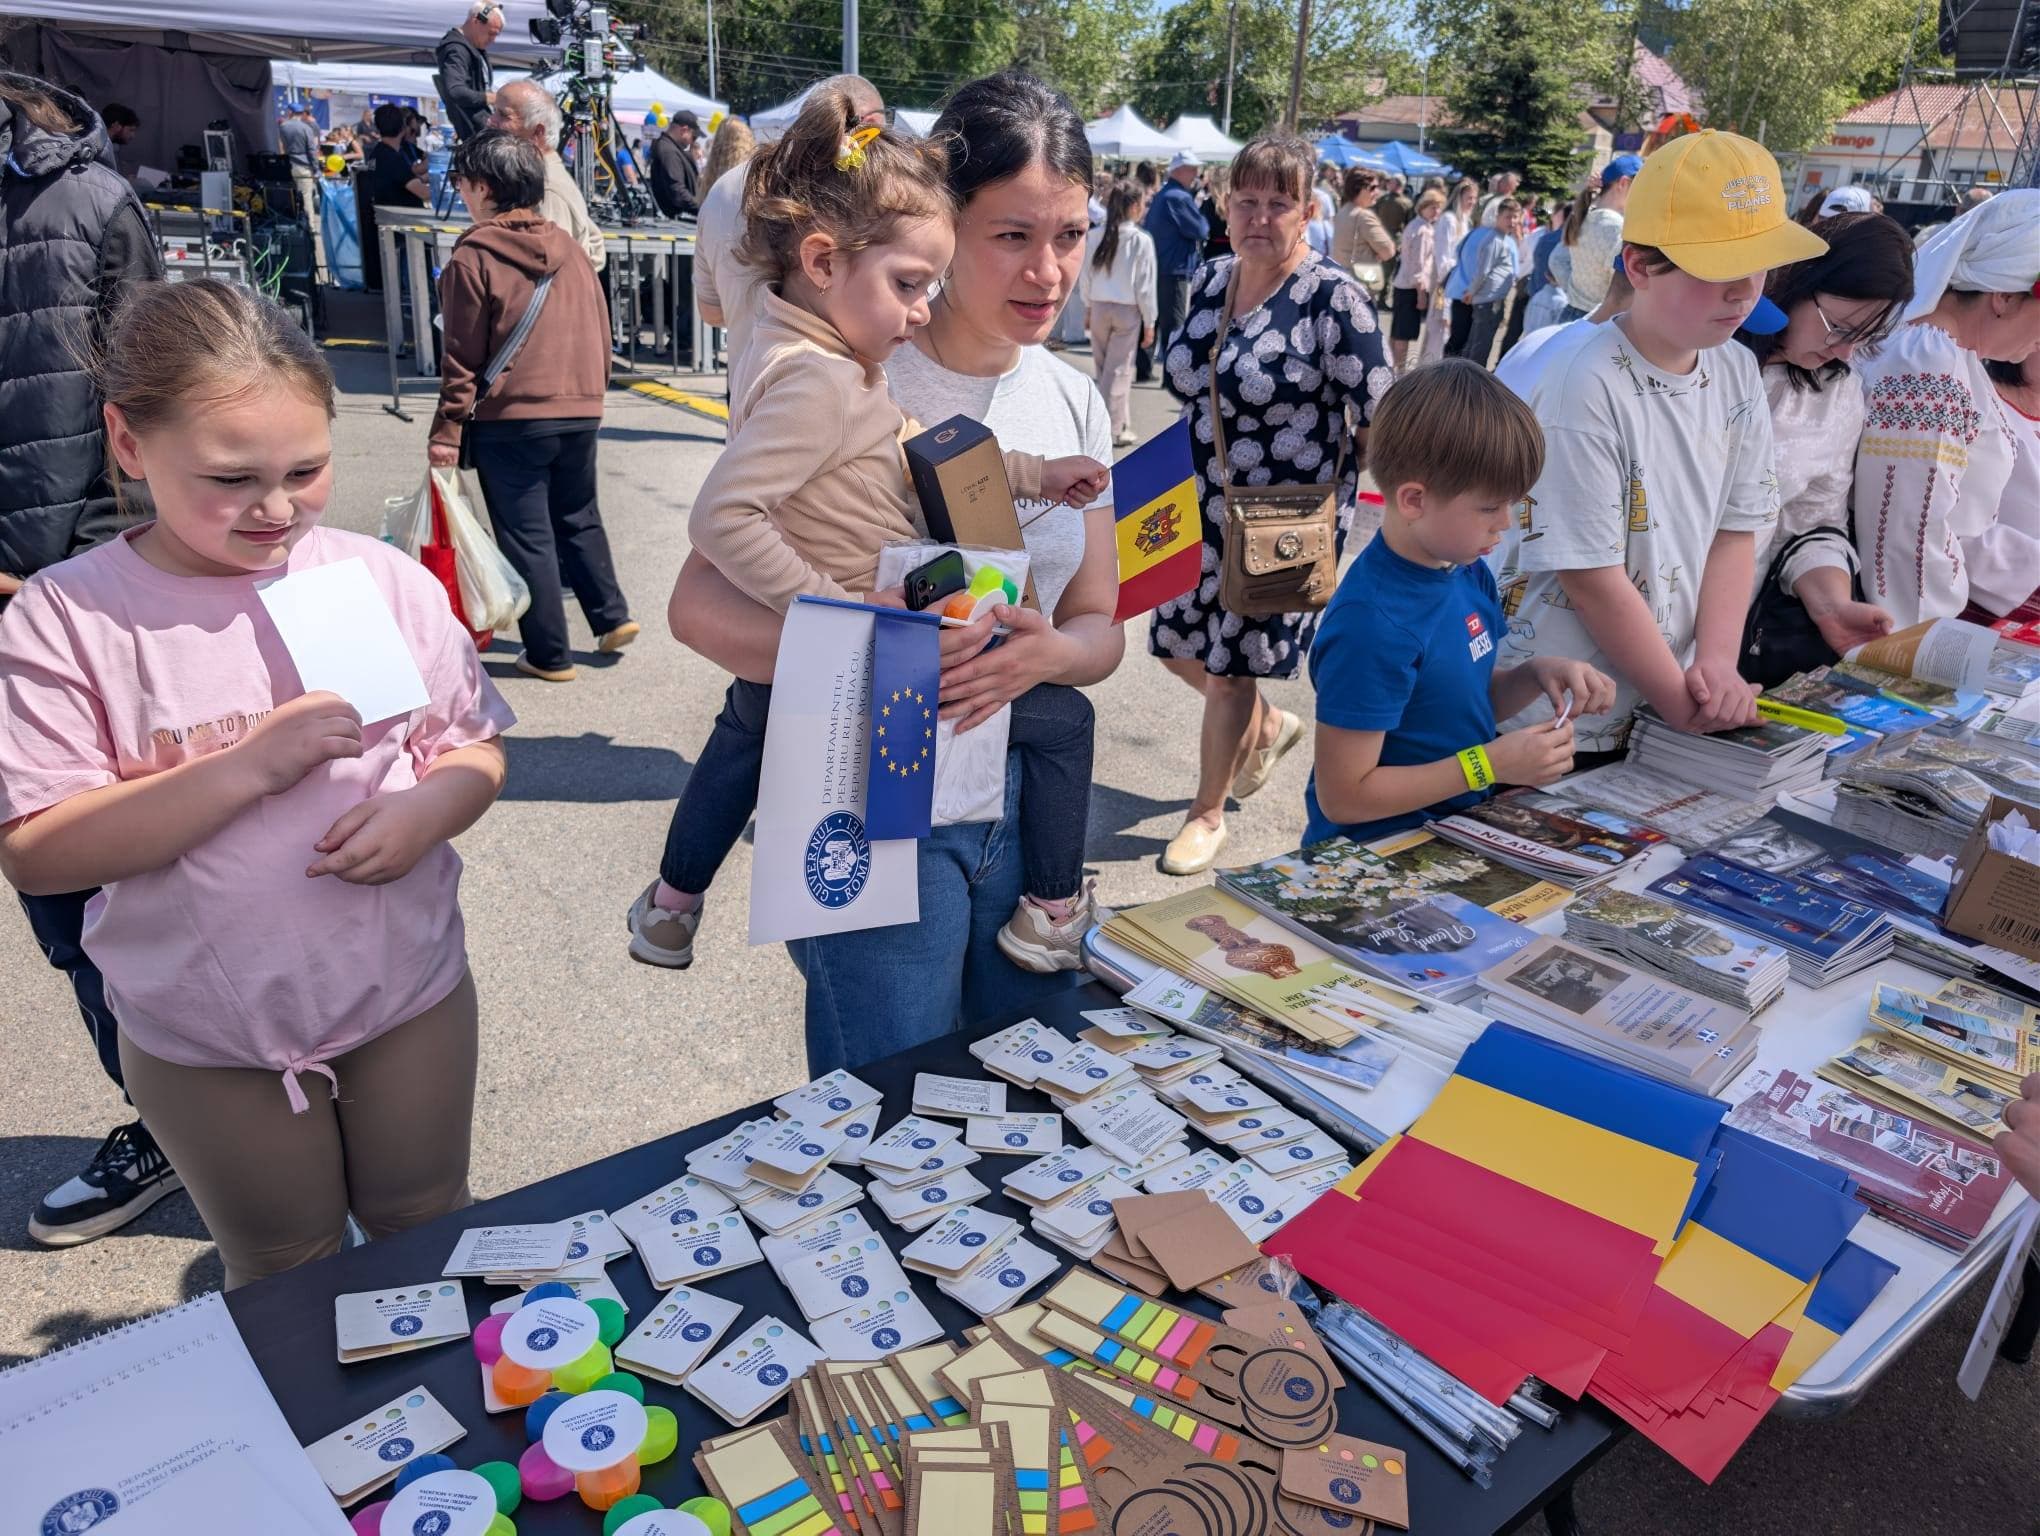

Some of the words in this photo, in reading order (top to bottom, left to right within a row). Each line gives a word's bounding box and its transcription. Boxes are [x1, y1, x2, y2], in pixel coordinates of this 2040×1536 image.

[217, 717, 235, 733] TO
[821, 670, 846, 805] DEPARTAMENTUL
[837, 743, 849, 804] PENTRU
[850, 651, 860, 675] CU
[850, 724, 866, 803] REPUBLICA
[858, 639, 876, 718] MOLDOVA
[807, 821, 833, 902] GUVERNUL
[117, 1438, 216, 1489] DEPARTAMENTUL
